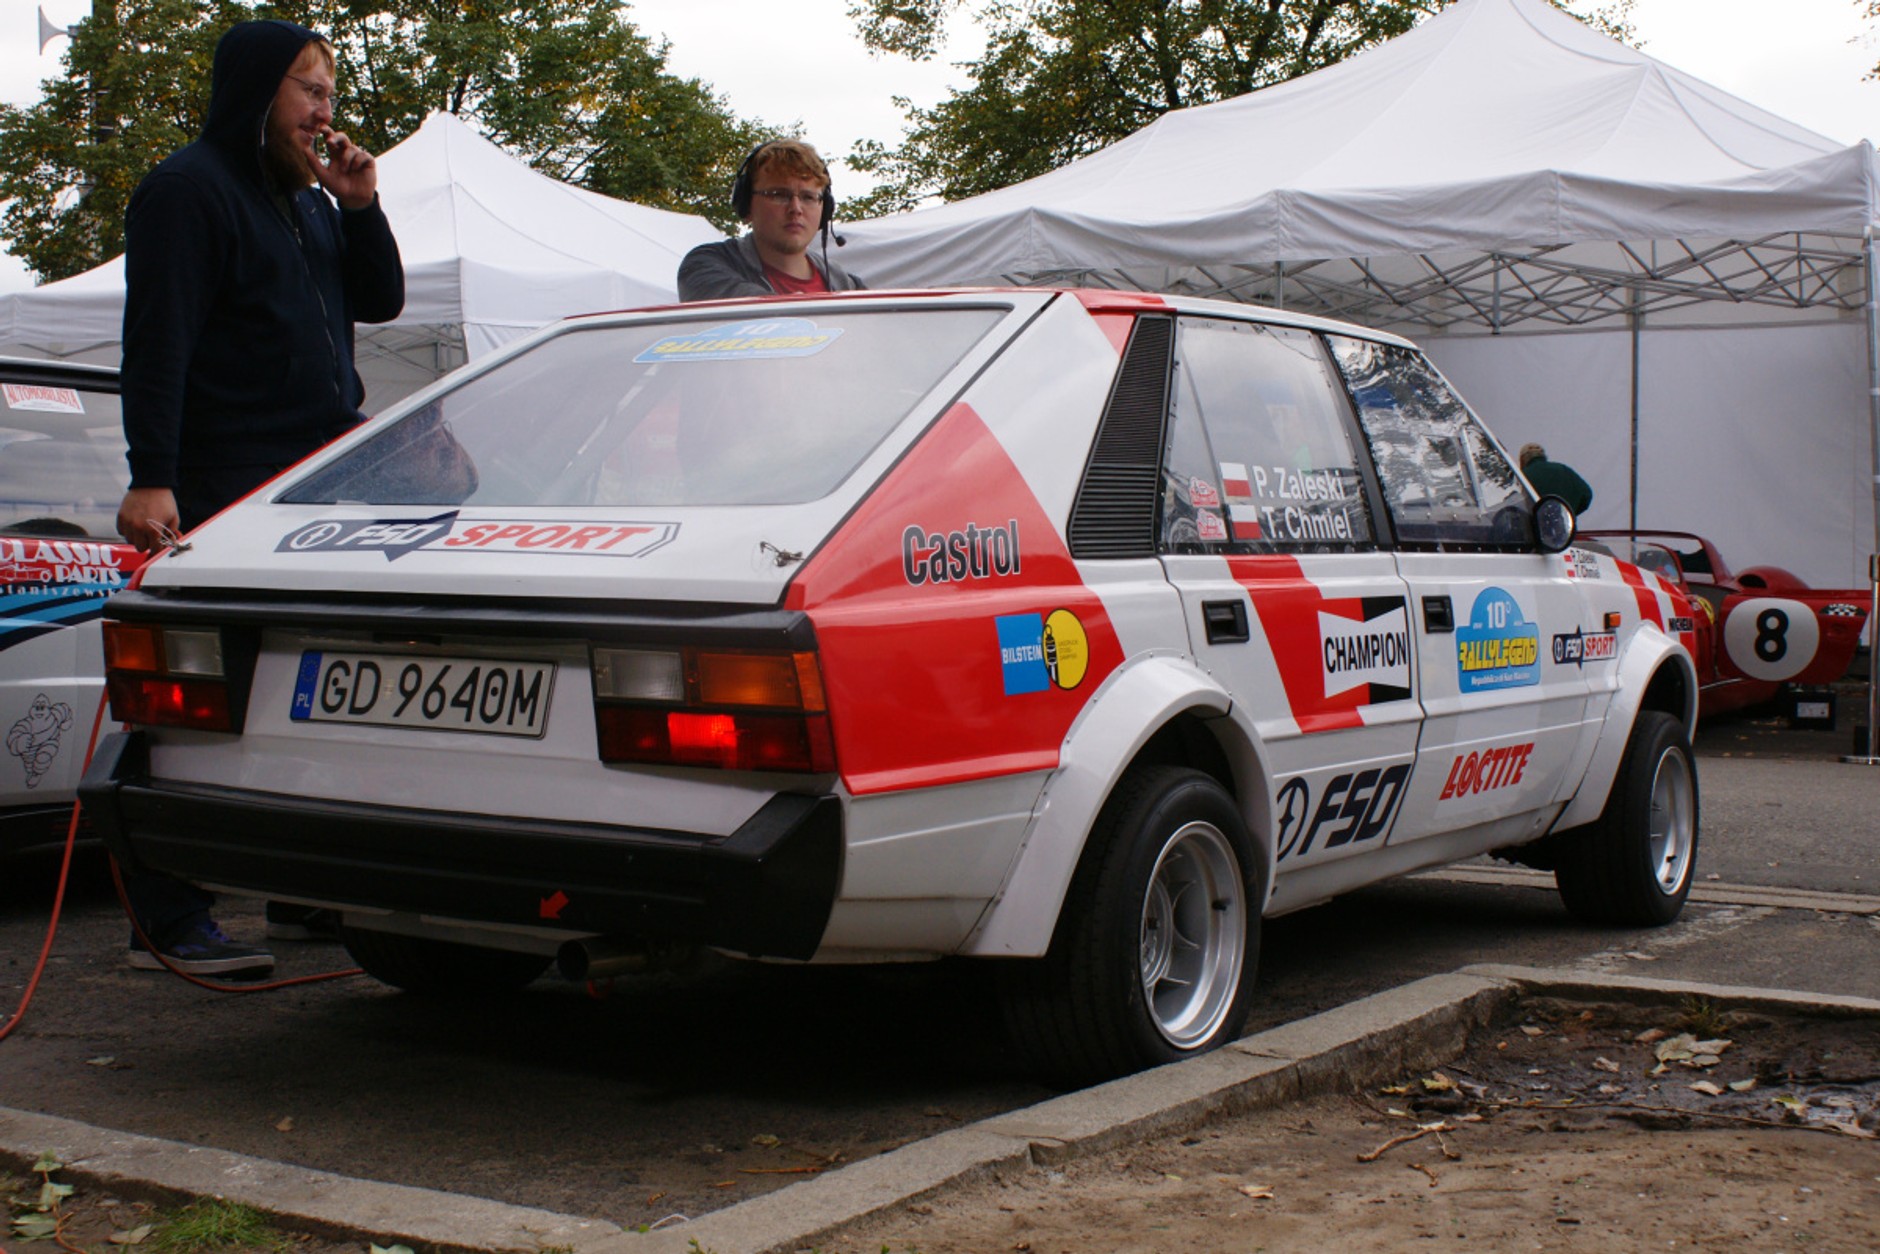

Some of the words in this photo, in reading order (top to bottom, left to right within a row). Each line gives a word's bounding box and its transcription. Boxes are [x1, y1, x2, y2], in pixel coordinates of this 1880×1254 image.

[1252, 465, 1274, 498] P.
[1274, 467, 1346, 500] Zaleski
[335, 523, 432, 546] FSO
[443, 523, 655, 550] SPORT
[1261, 506, 1283, 538] T.
[1285, 506, 1353, 539] Chmiel
[902, 519, 1020, 586] Castrol
[55, 564, 122, 585] PARTS
[1324, 632, 1407, 673] CHAMPION
[1585, 636, 1614, 657] SPORT
[1754, 608, 1789, 662] 8
[1002, 644, 1043, 664] BILSTEIN
[1459, 636, 1538, 671] RALLYLEGEND
[296, 693, 310, 707] PL
[320, 660, 382, 715] GD
[393, 662, 543, 727] 9640M
[1439, 743, 1535, 800] LOCTITE
[1296, 763, 1412, 856] FSO
